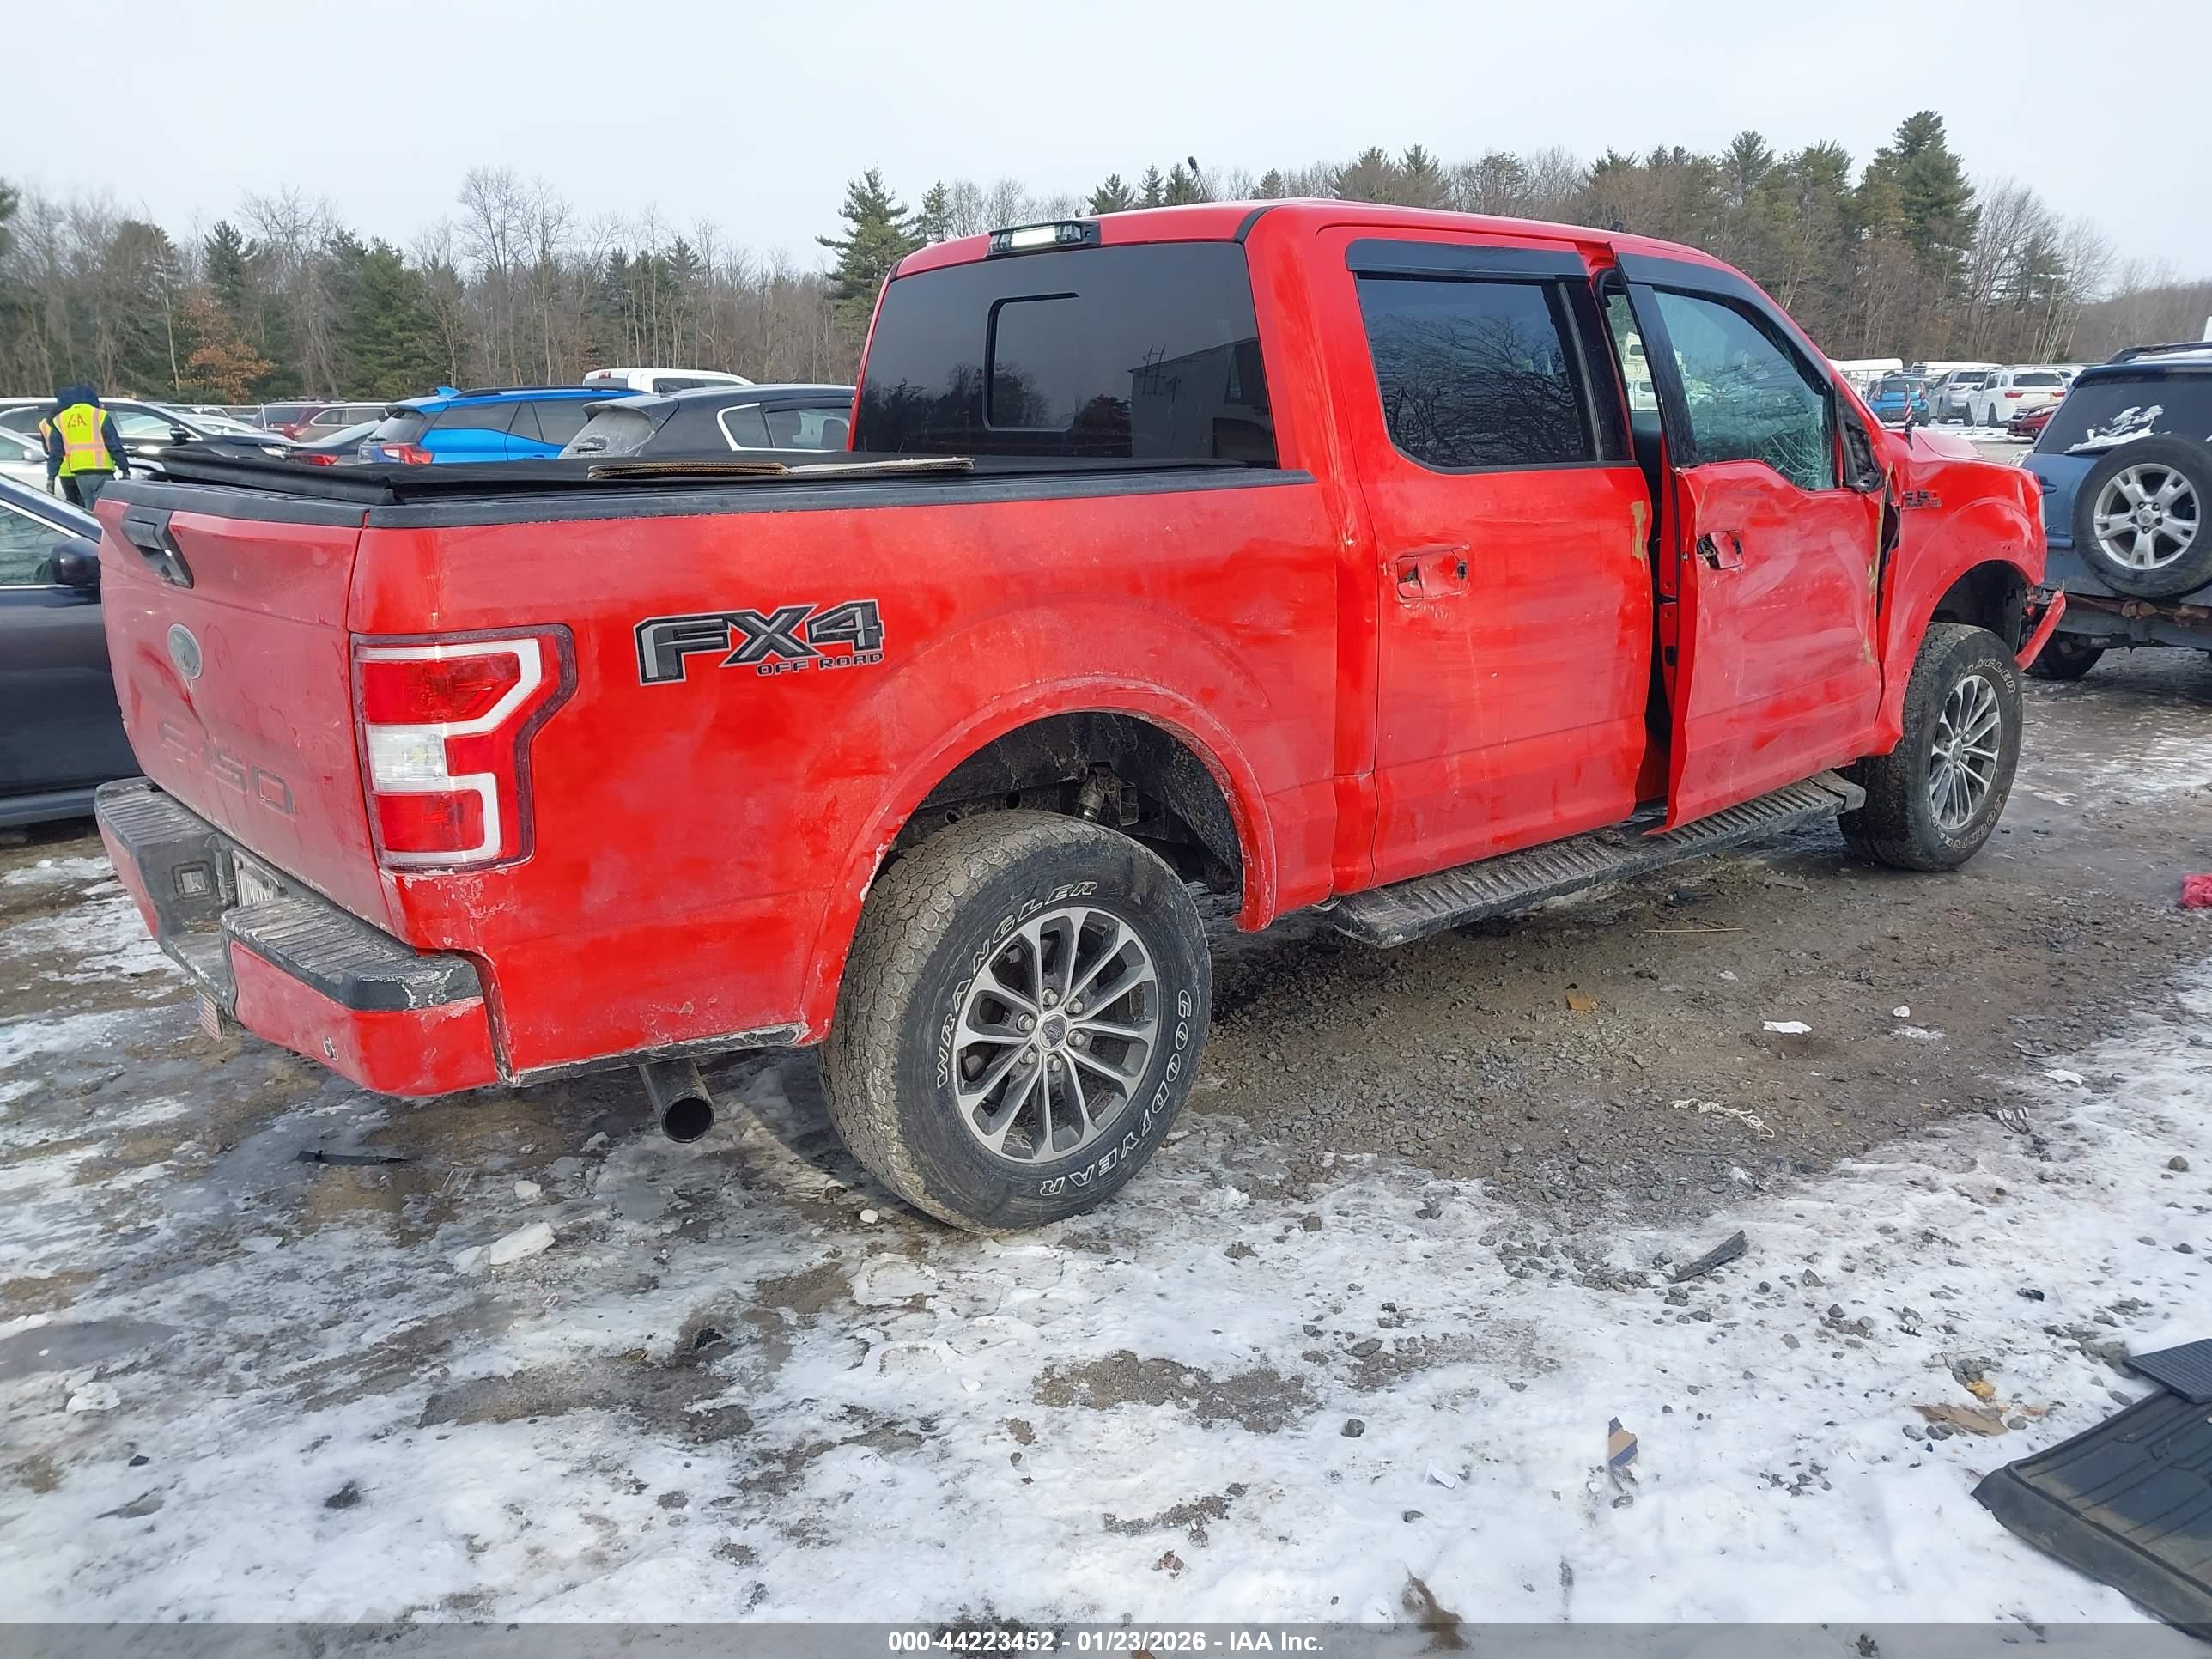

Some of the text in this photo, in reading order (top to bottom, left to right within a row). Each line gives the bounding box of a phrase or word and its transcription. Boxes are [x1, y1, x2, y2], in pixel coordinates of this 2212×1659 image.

[633, 598, 885, 687] FX4
[756, 652, 884, 677] OFF ROAD
[936, 880, 1099, 1090] WRANGLER
[1040, 988, 1194, 1197] GOODYEAR
